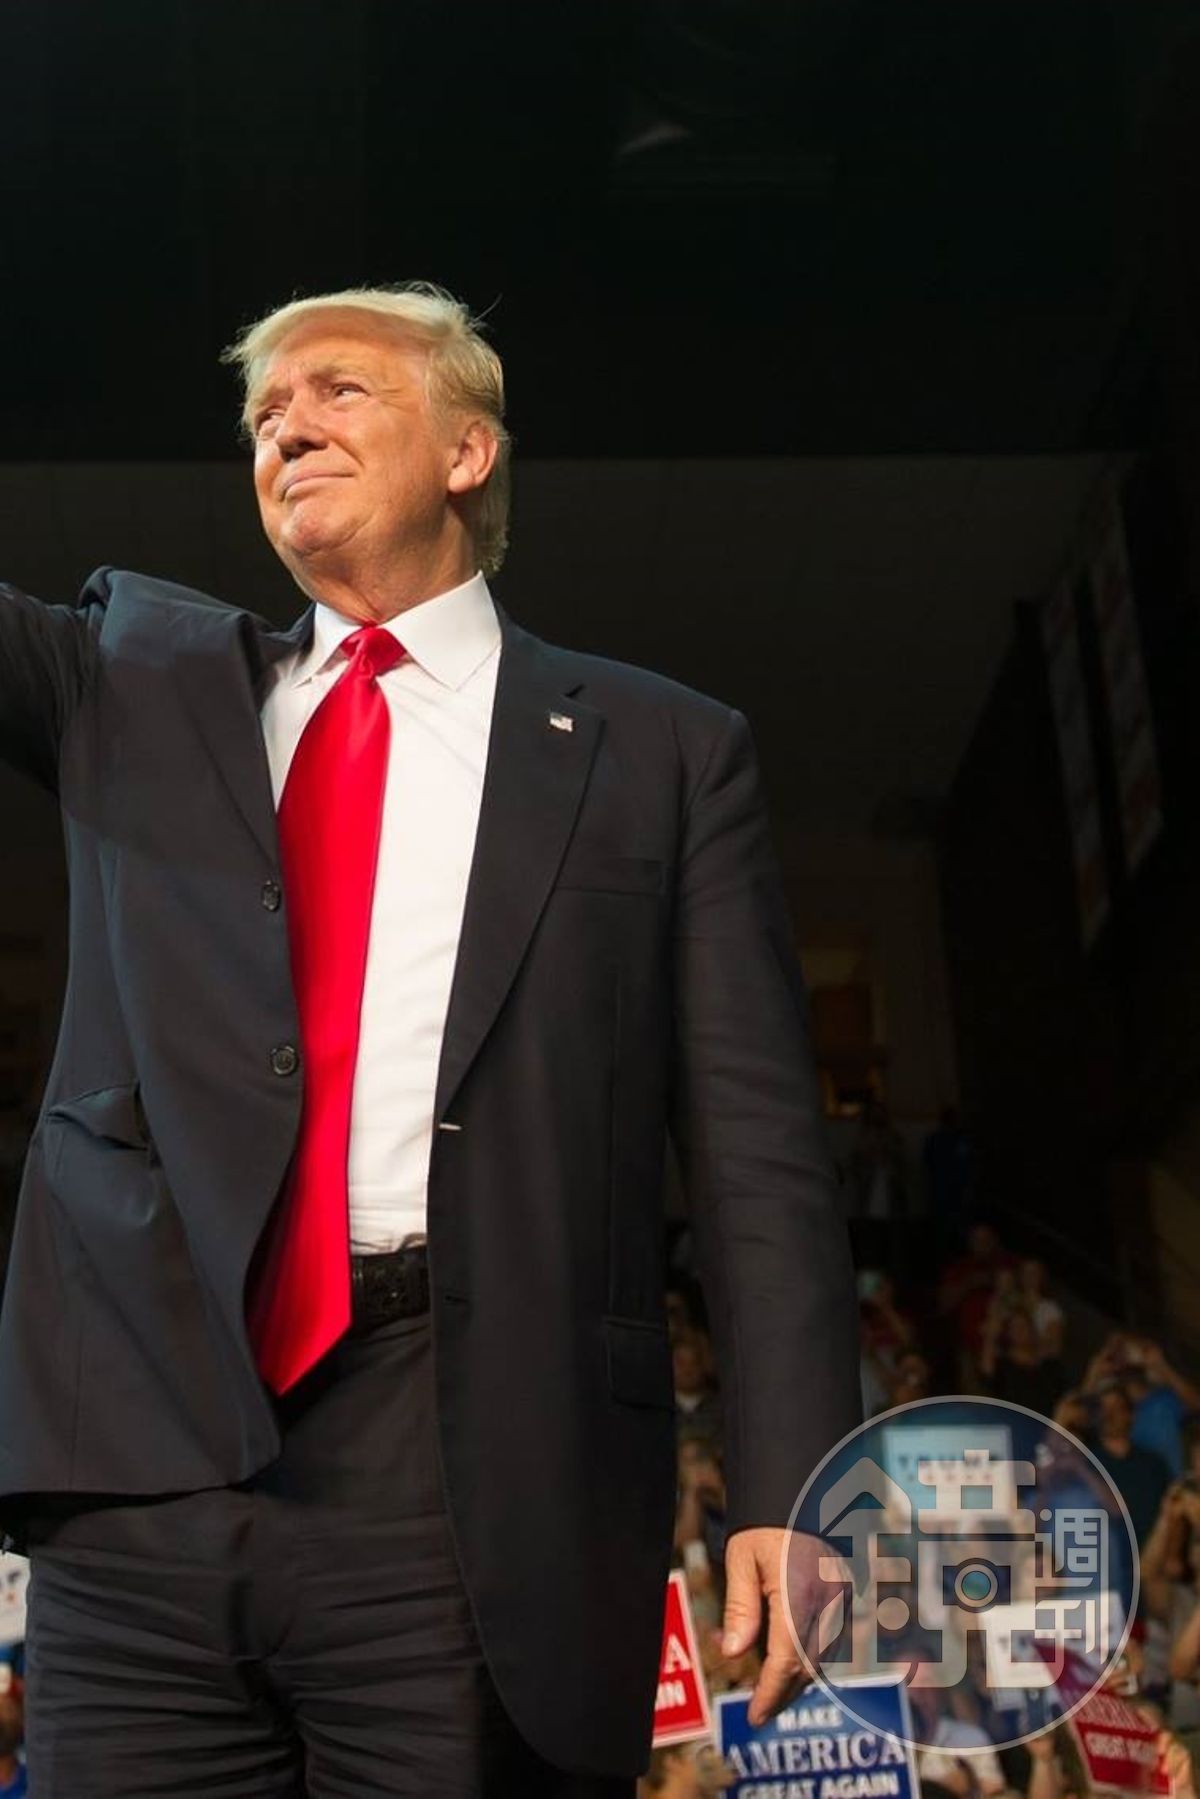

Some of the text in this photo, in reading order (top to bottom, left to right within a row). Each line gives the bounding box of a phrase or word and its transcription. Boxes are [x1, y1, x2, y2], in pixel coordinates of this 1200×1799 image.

[775, 1705, 842, 1732] MAKE
[727, 1730, 906, 1780] AMERICA
[818, 1771, 900, 1799] AGAIN
